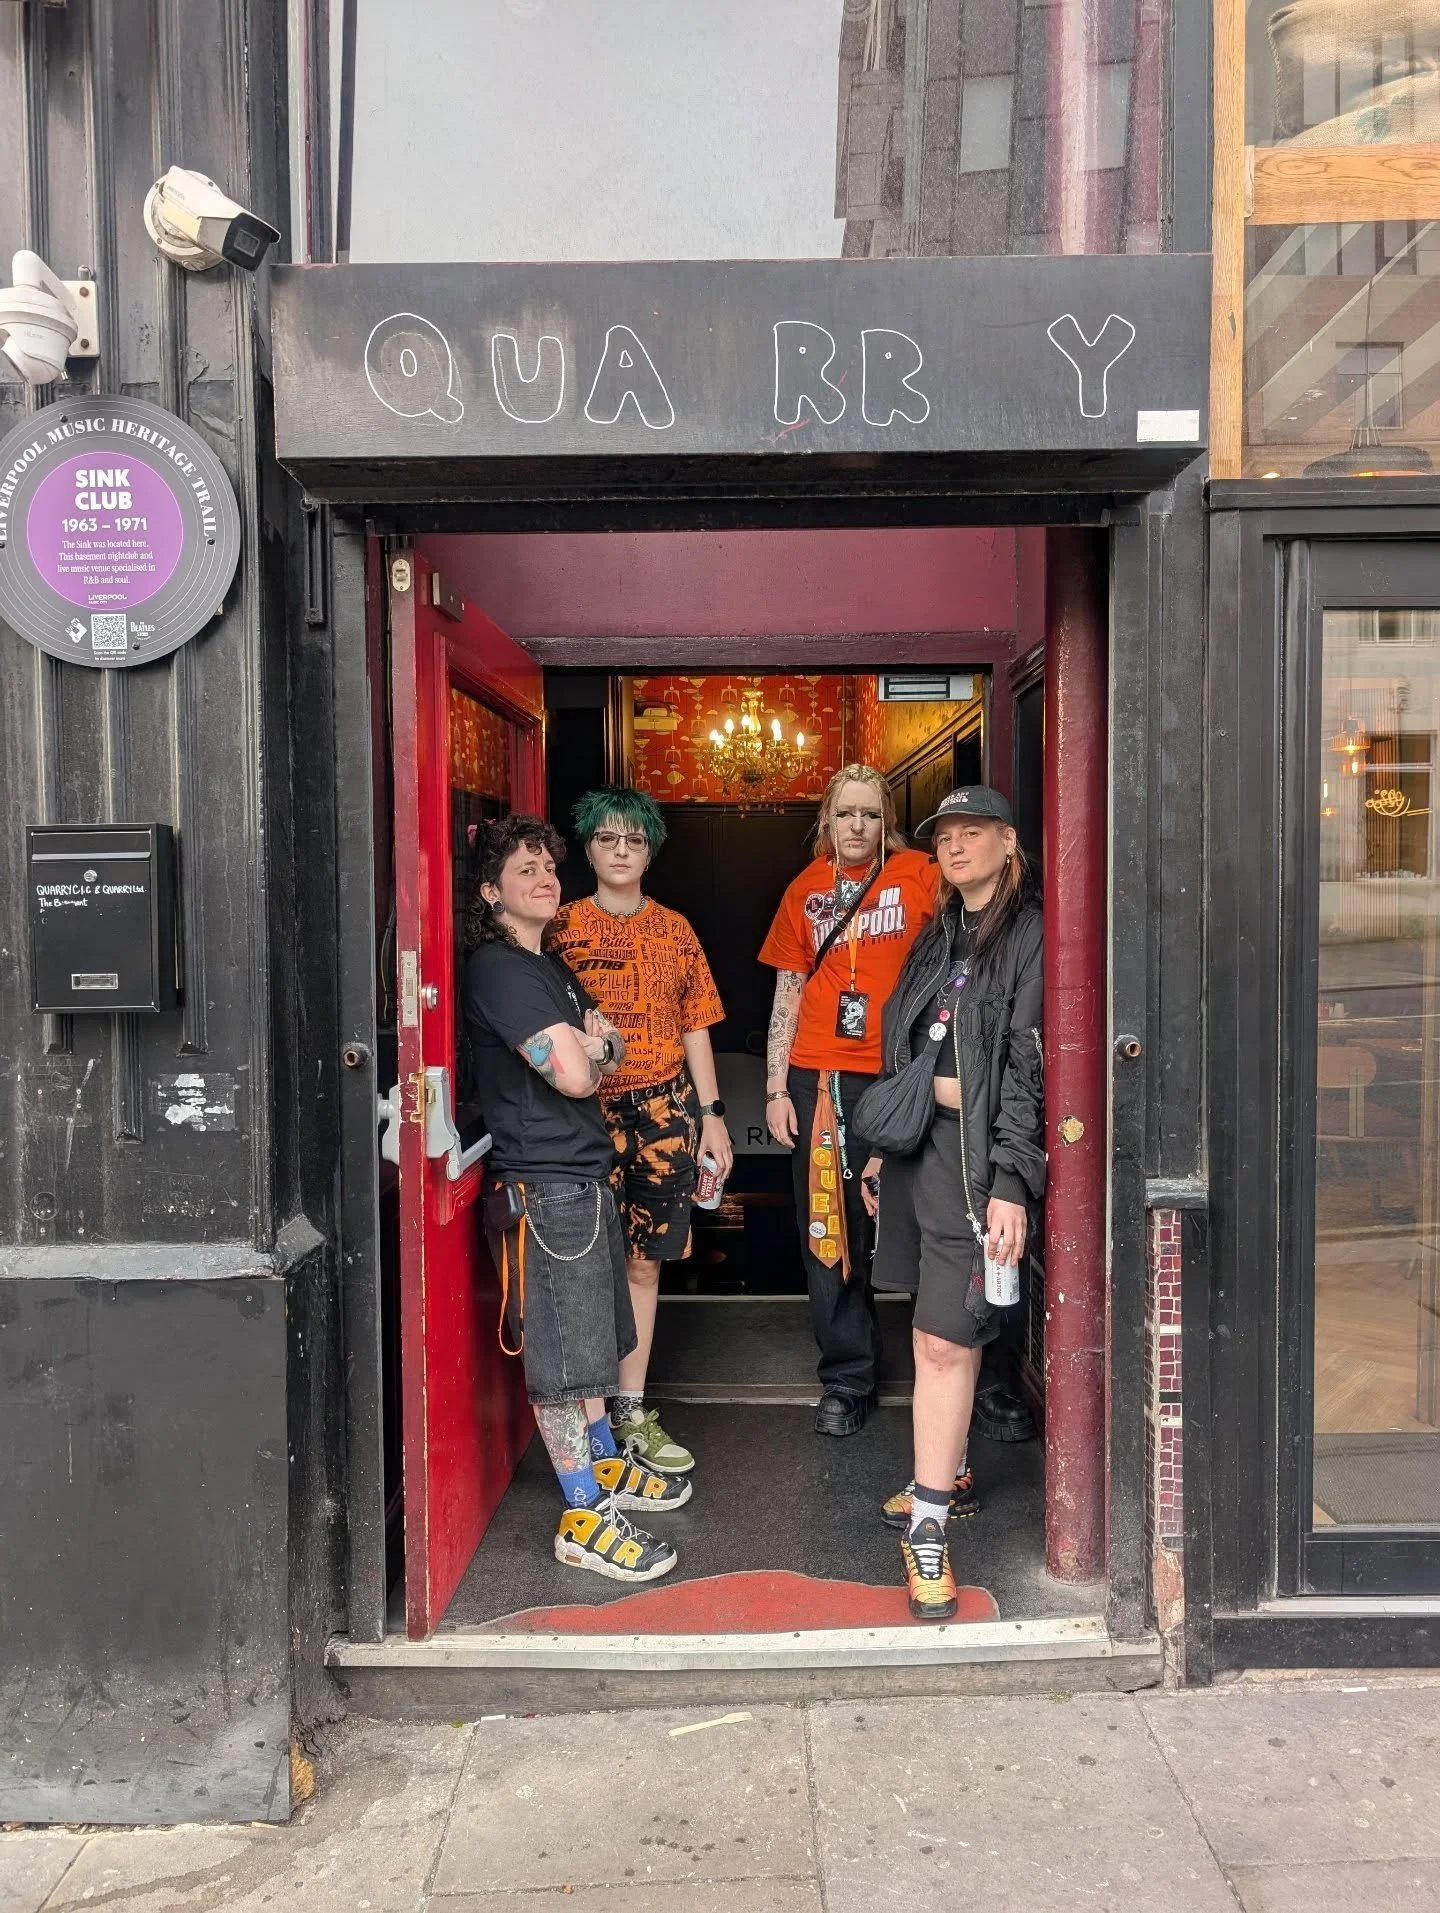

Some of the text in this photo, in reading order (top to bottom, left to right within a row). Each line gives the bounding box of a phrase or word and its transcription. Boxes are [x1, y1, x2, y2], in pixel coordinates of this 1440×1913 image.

[46, 418, 106, 445] MUSIC
[112, 419, 196, 477] HERITAGE
[191, 477, 217, 537] TRAIL
[75, 469, 131, 488] SINK
[75, 491, 133, 510] CLUB
[62, 518, 98, 532] 1963
[115, 517, 148, 531] 1971
[62, 541, 75, 549] The
[76, 540, 92, 549] Sink
[107, 540, 130, 548] located
[132, 540, 149, 548] here.
[59, 551, 153, 562] This basement nightclub and
[57, 564, 69, 573] live
[70, 564, 90, 573] music
[112, 563, 147, 573] specialised
[149, 563, 156, 571] in
[83, 576, 131, 584] R&B and soul.
[88, 593, 128, 601] LIVERPOOL
[130, 621, 155, 632] BEATLES
[36, 885, 72, 896] QUARRY
[102, 885, 133, 895] QUARRY
[38, 898, 53, 908] The
[600, 937, 635, 948] Billie
[599, 973, 633, 989] BILLIE
[692, 1007, 719, 1025] BILLIE
[593, 1458, 668, 1499] AIR
[559, 1508, 643, 1568] AIR
